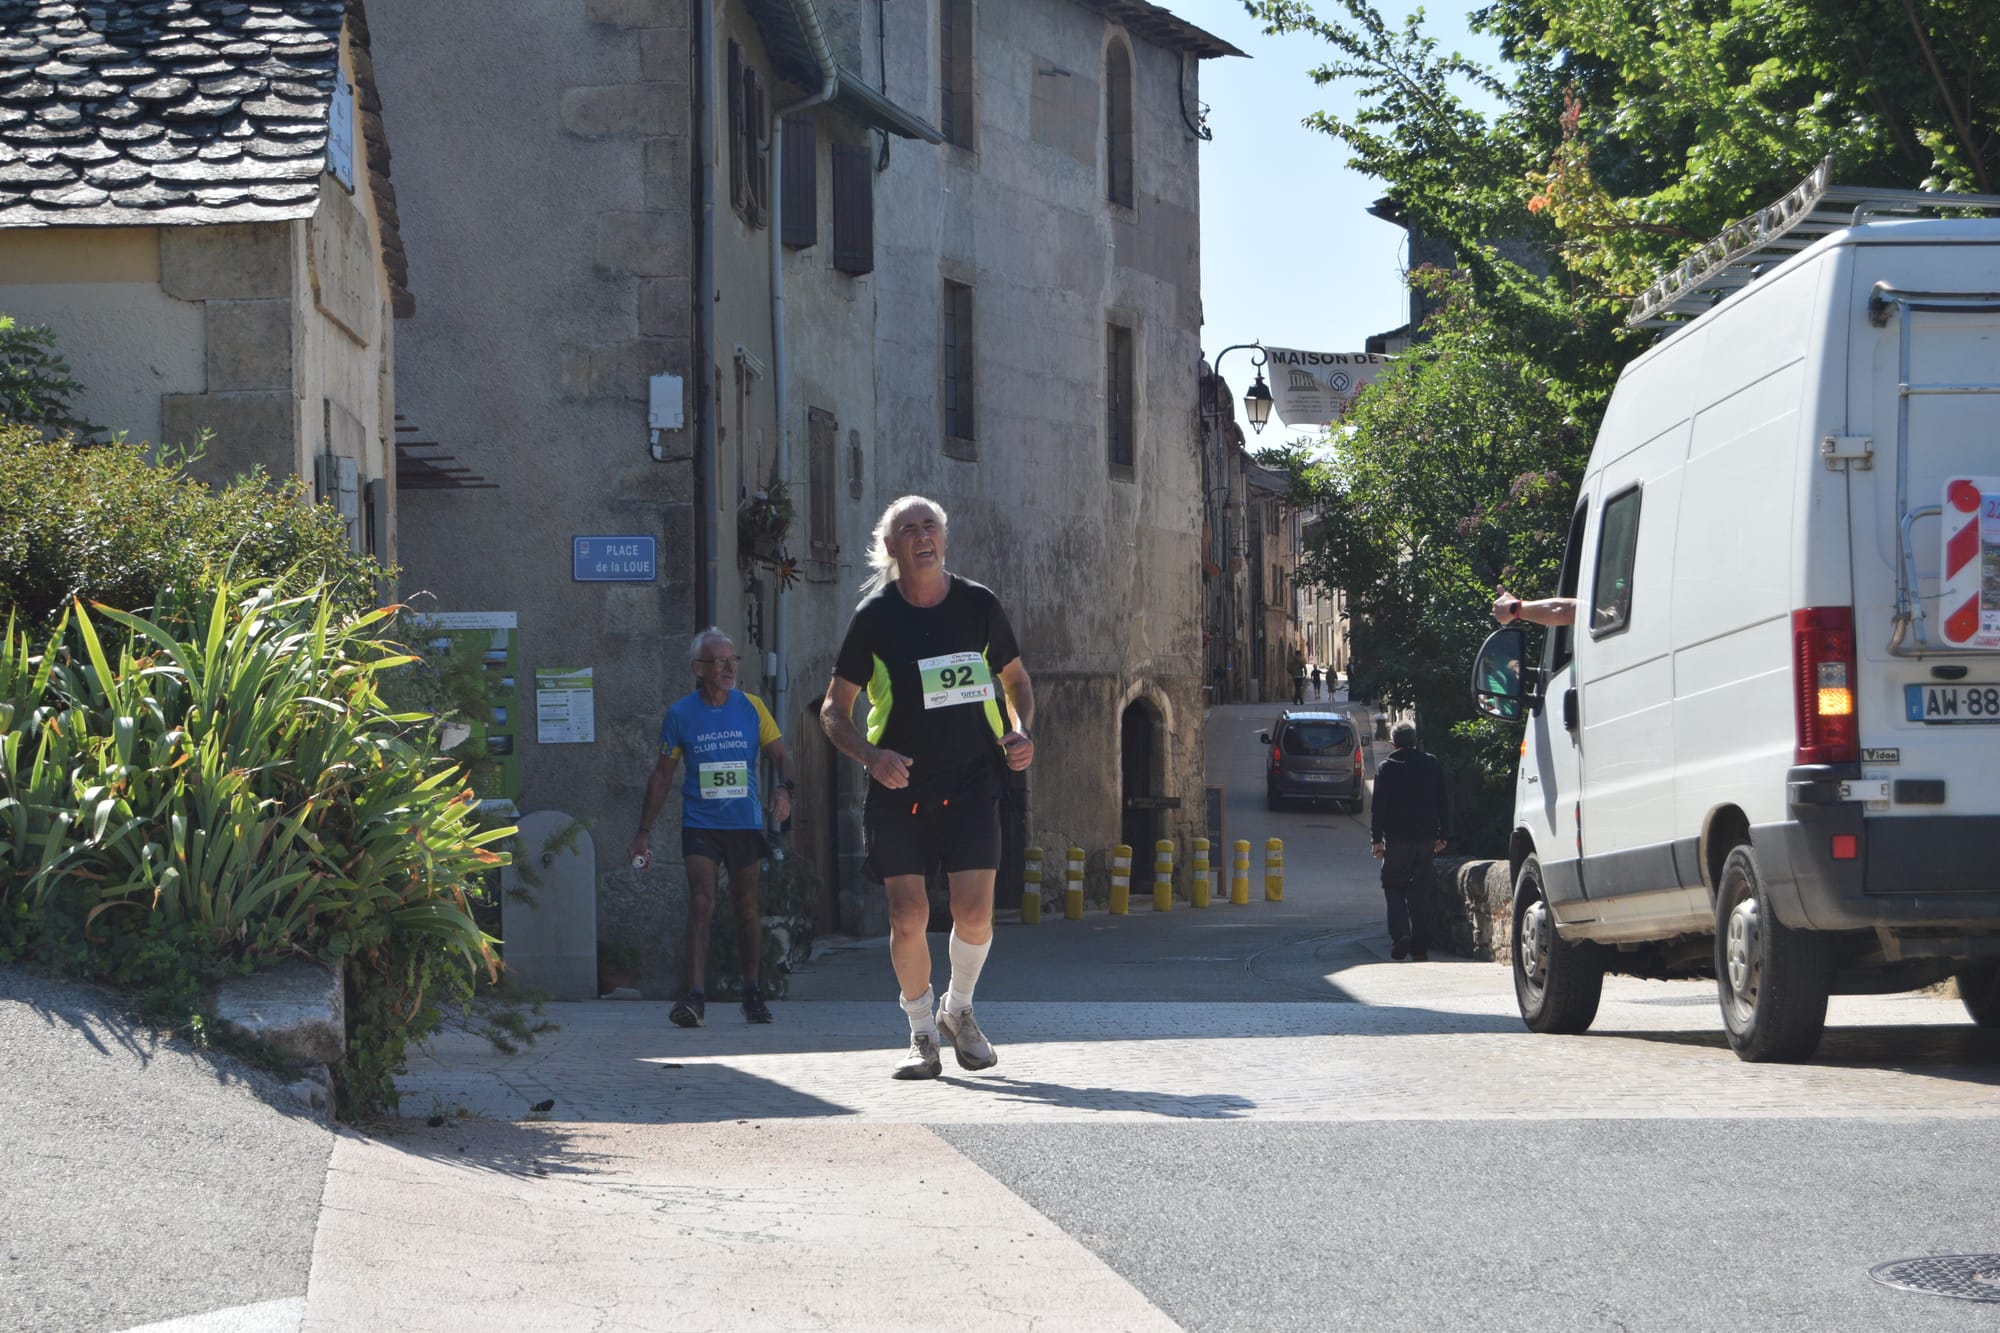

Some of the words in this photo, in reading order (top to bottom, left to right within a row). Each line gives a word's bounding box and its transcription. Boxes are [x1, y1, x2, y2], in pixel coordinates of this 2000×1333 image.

[1271, 351, 1348, 365] MAISON
[1354, 354, 1378, 364] DE
[606, 544, 639, 556] PLACE
[596, 561, 608, 573] de
[611, 561, 620, 573] la
[623, 561, 649, 573] LOUE
[940, 665, 974, 688] 92
[697, 730, 743, 742] MACADAM
[694, 742, 717, 753] CLUB
[713, 771, 736, 787] 58
